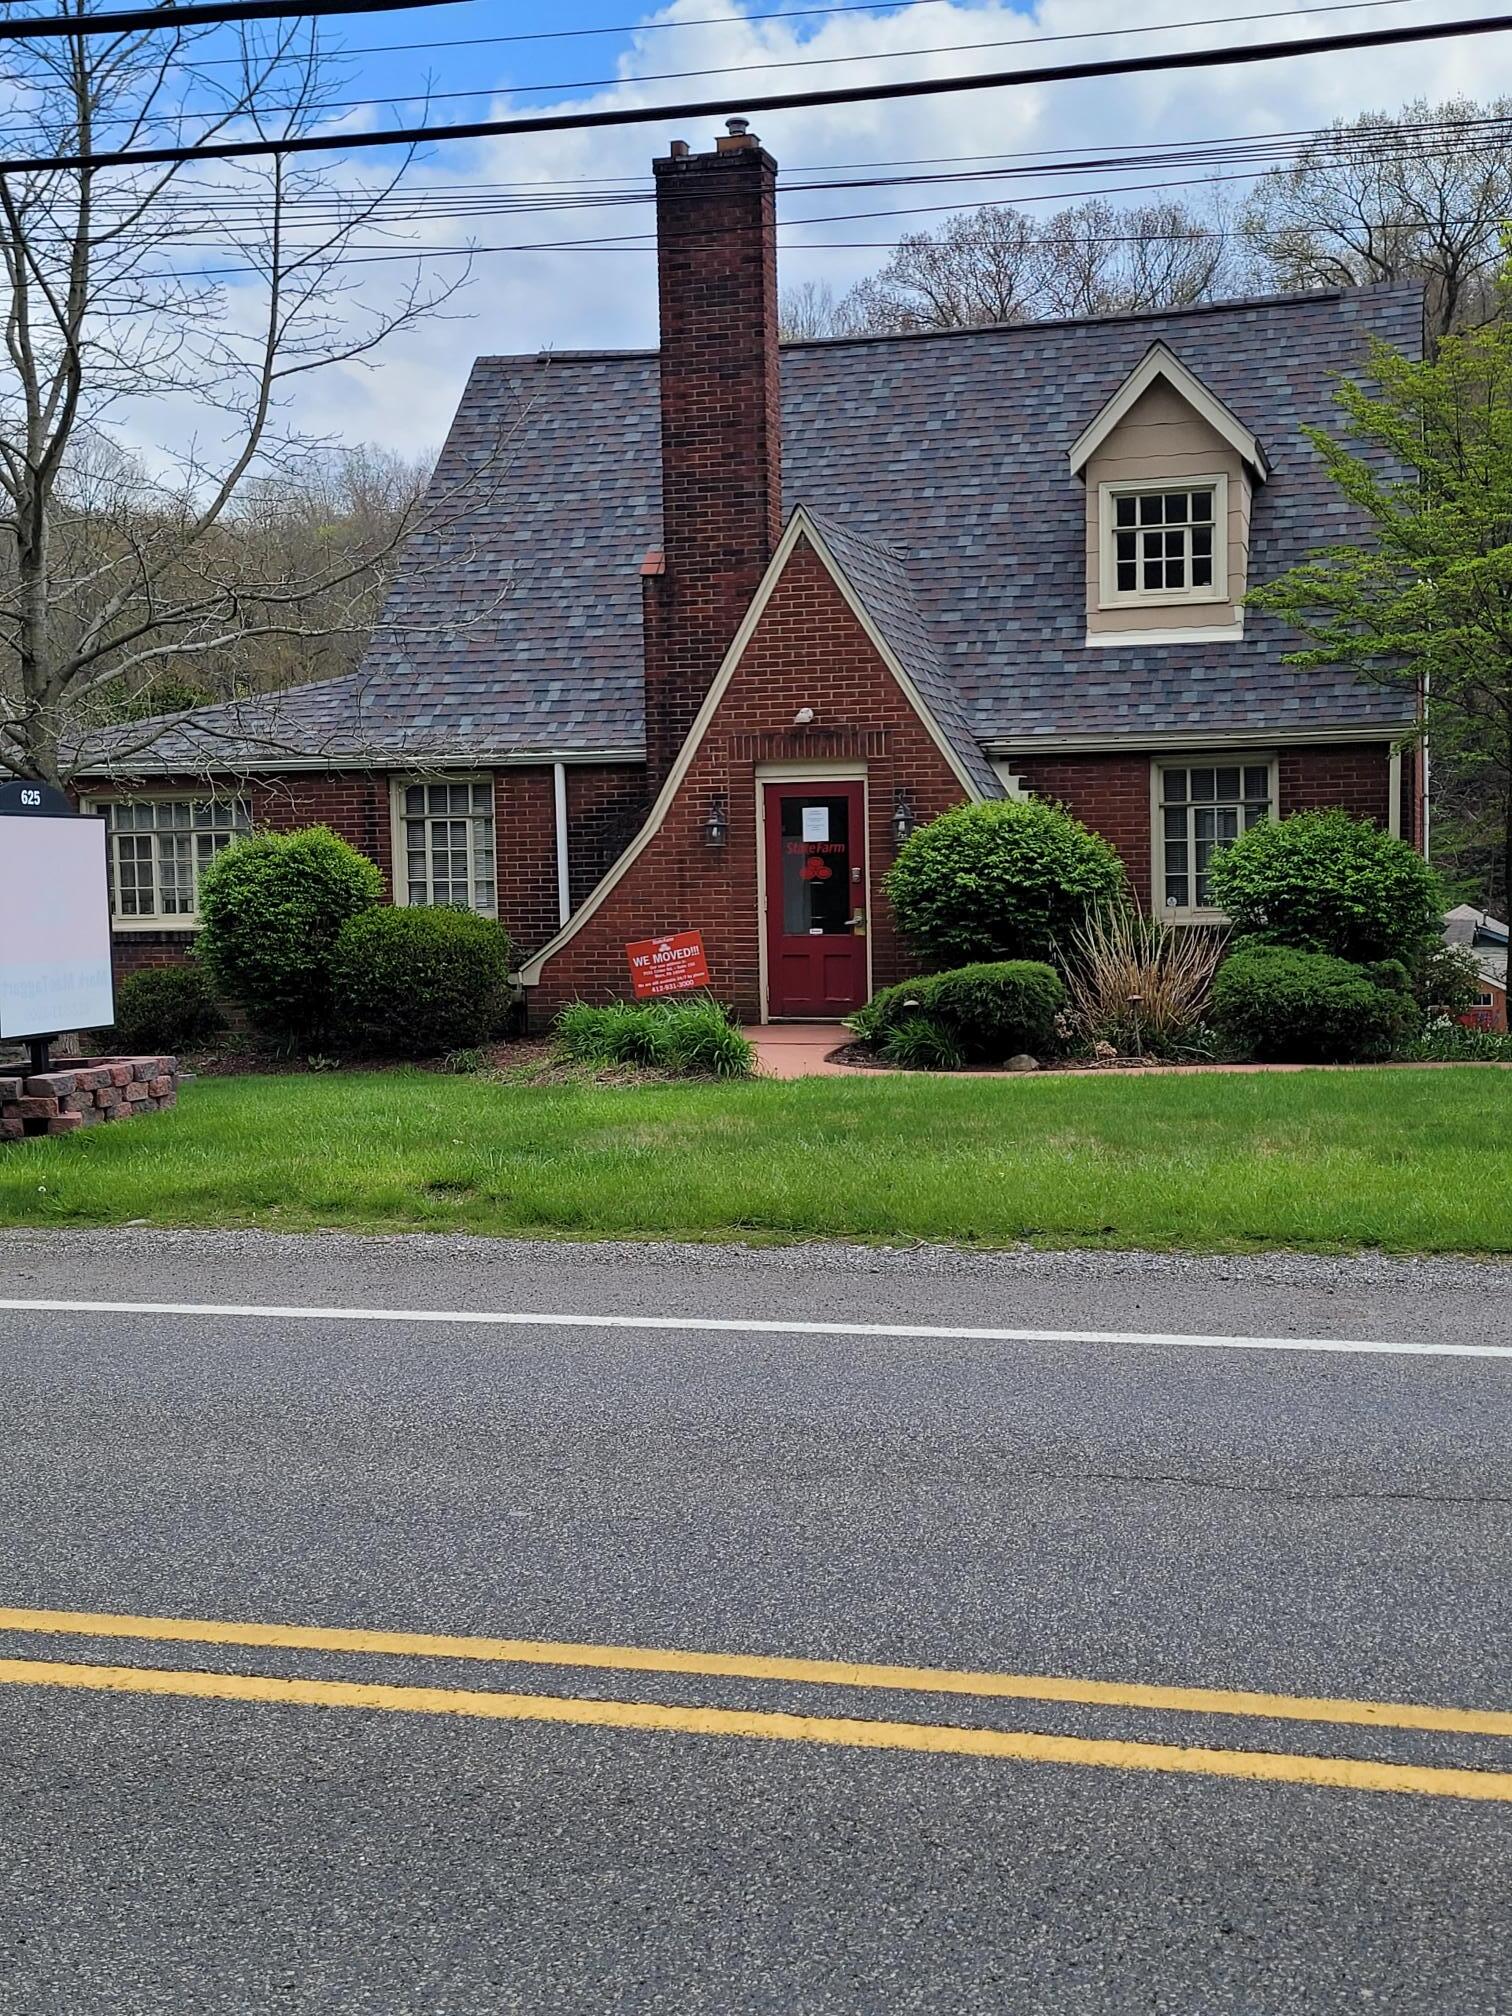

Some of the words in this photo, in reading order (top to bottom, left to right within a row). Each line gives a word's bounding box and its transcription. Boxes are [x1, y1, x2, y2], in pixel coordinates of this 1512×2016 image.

[21, 790, 40, 805] 625
[632, 955, 651, 967] WE
[652, 945, 700, 964] MOVED!!!
[652, 979, 695, 993] 412-931-3000
